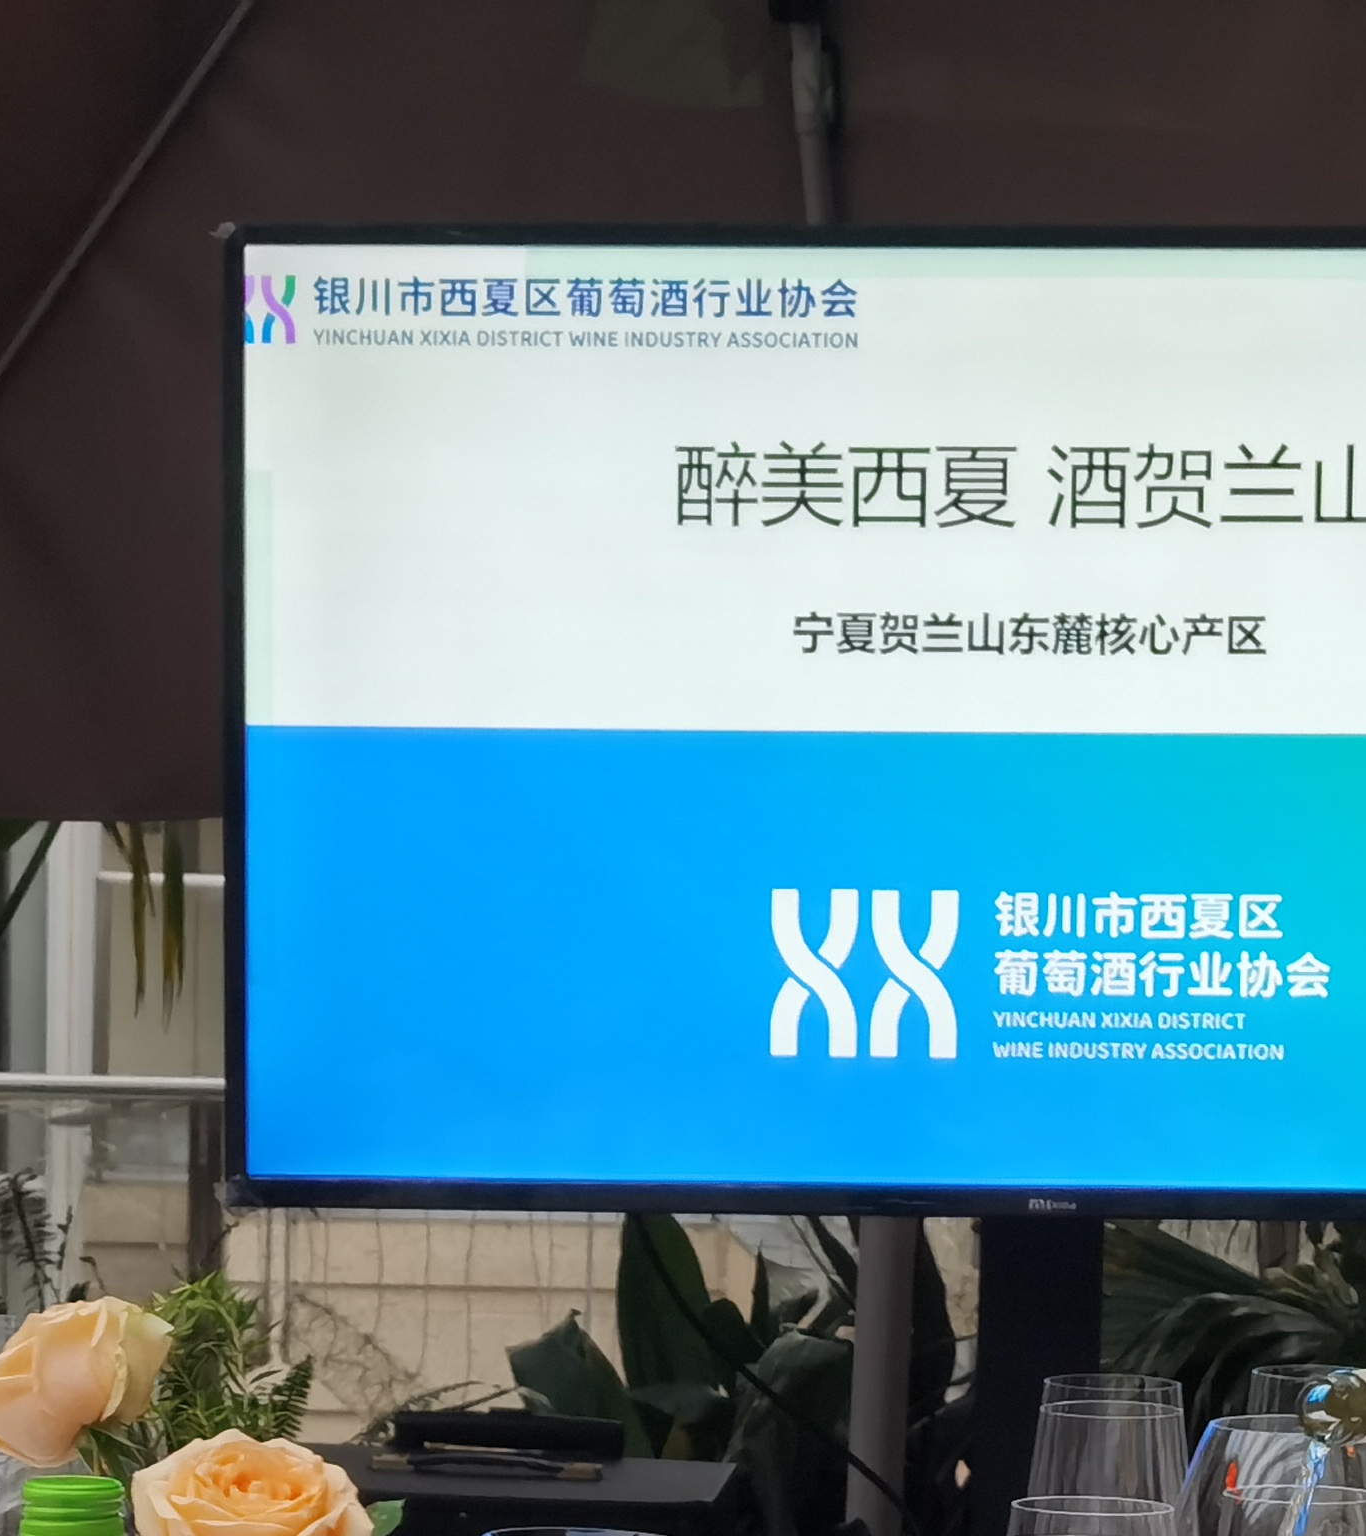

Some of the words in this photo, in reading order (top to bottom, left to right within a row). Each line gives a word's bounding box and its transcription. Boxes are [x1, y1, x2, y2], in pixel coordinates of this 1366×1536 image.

[313, 275, 858, 319] 银川市西夏区葡萄酒行业协会
[313, 328, 414, 347] YINCHUAN
[420, 329, 471, 347] XIXIA
[476, 329, 563, 348] DISTRICT
[569, 331, 618, 348] WINE
[624, 331, 721, 349] INDUSTRY
[727, 331, 858, 350] ASSOCIATION
[674, 440, 1018, 529] 醉美西夏
[792, 610, 1267, 657] 宁夏贺兰山东麓核心产区
[995, 892, 1283, 939] 银川市西夏区
[994, 951, 1330, 999] 葡萄酒行业协会
[993, 1011, 1096, 1029] YINCHUAN
[1101, 1011, 1153, 1030] XIXIA
[1158, 1012, 1246, 1030] DISTRICT
[992, 1041, 1044, 1059] WINE
[1048, 1041, 1147, 1060] INDUSTRY
[1151, 1042, 1284, 1061] ASSOCIATION
